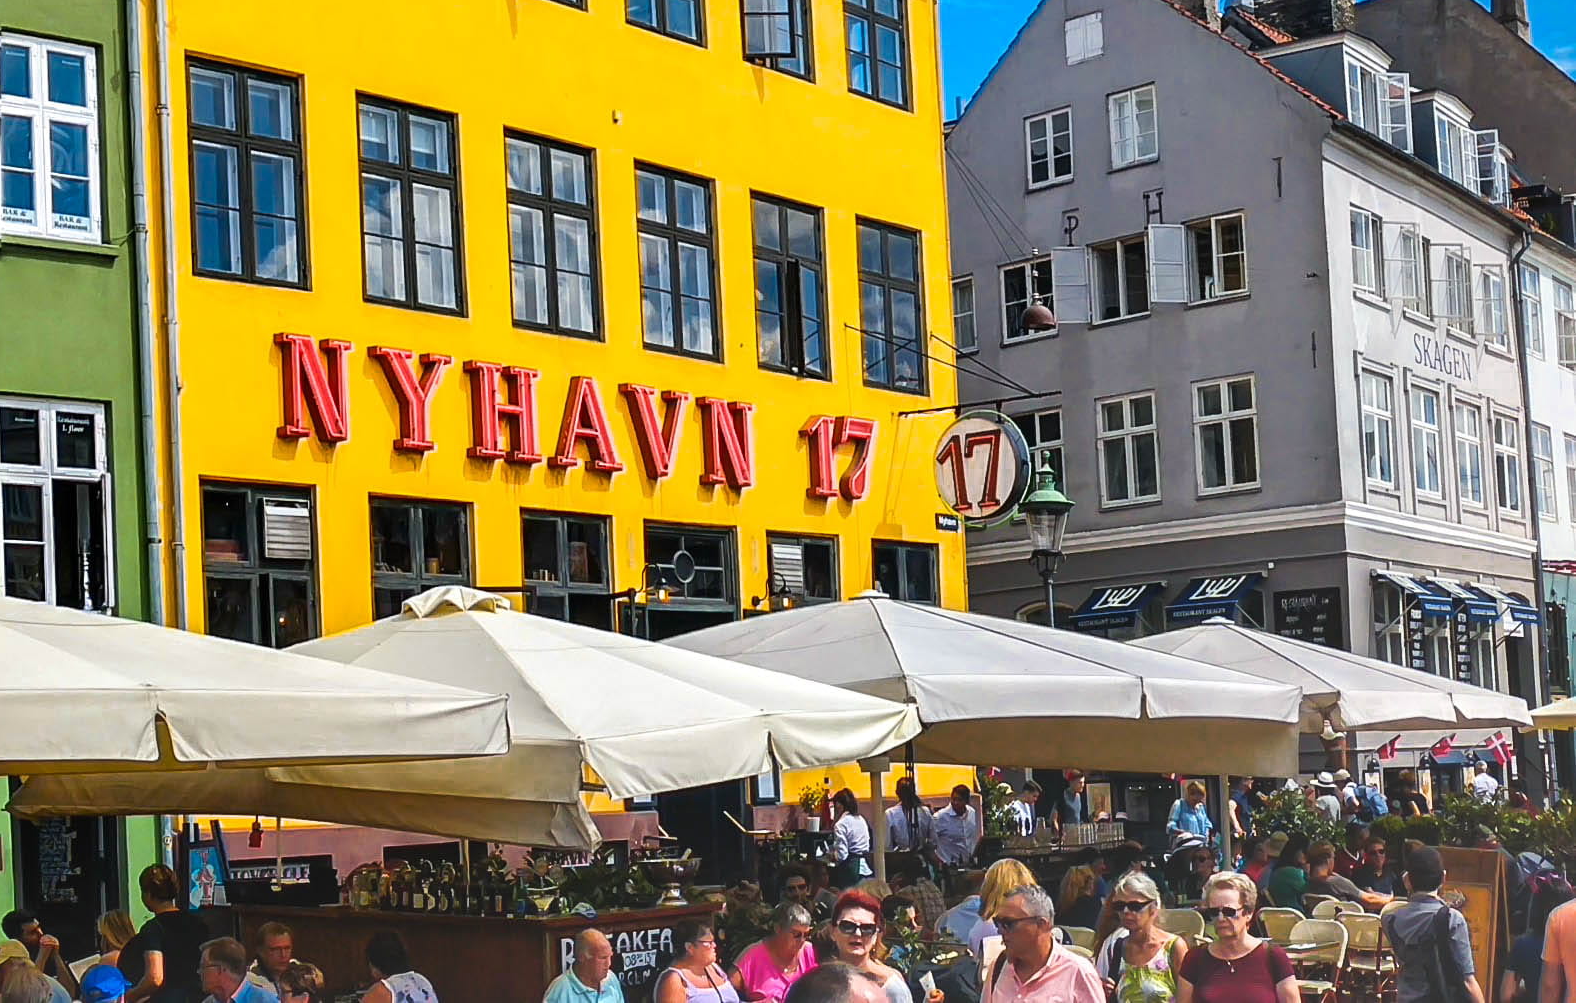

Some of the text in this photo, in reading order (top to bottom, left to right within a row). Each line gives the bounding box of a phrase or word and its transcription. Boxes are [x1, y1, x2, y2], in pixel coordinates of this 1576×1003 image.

[2, 214, 33, 224] estaurant
[59, 215, 75, 223] BAR
[1413, 333, 1472, 383] SKAGEN
[274, 332, 879, 499] NYHAVN 17
[936, 429, 1001, 511] 17
